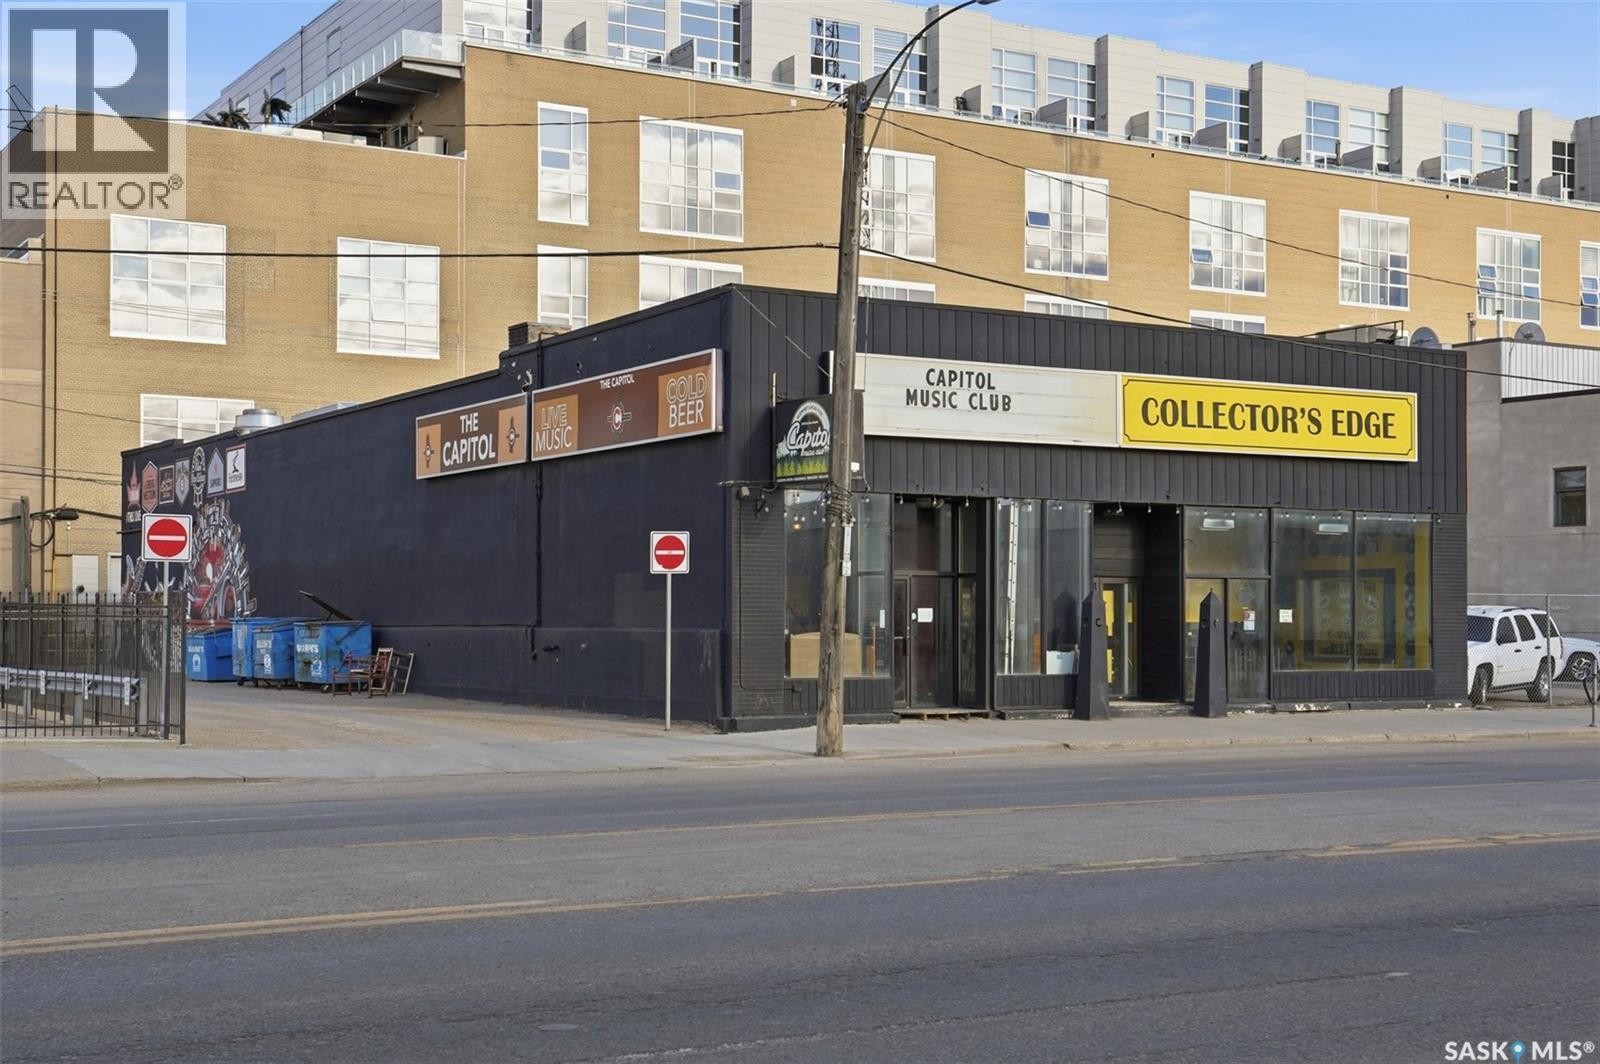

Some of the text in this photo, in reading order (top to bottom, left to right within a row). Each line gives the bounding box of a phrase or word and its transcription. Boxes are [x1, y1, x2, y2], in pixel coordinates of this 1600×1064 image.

[600, 373, 635, 390] THE CAPITOL
[665, 371, 709, 401] COLD
[925, 368, 996, 390] CAPITOL
[668, 398, 705, 429] BEER
[905, 388, 1012, 412] MUSIC CLUB
[460, 412, 479, 434] THE
[540, 403, 568, 430] LIVE
[1141, 397, 1397, 440] COLLECTOR'S EDGE
[442, 433, 496, 467] CAPITOL
[535, 425, 574, 452] MUSIC
